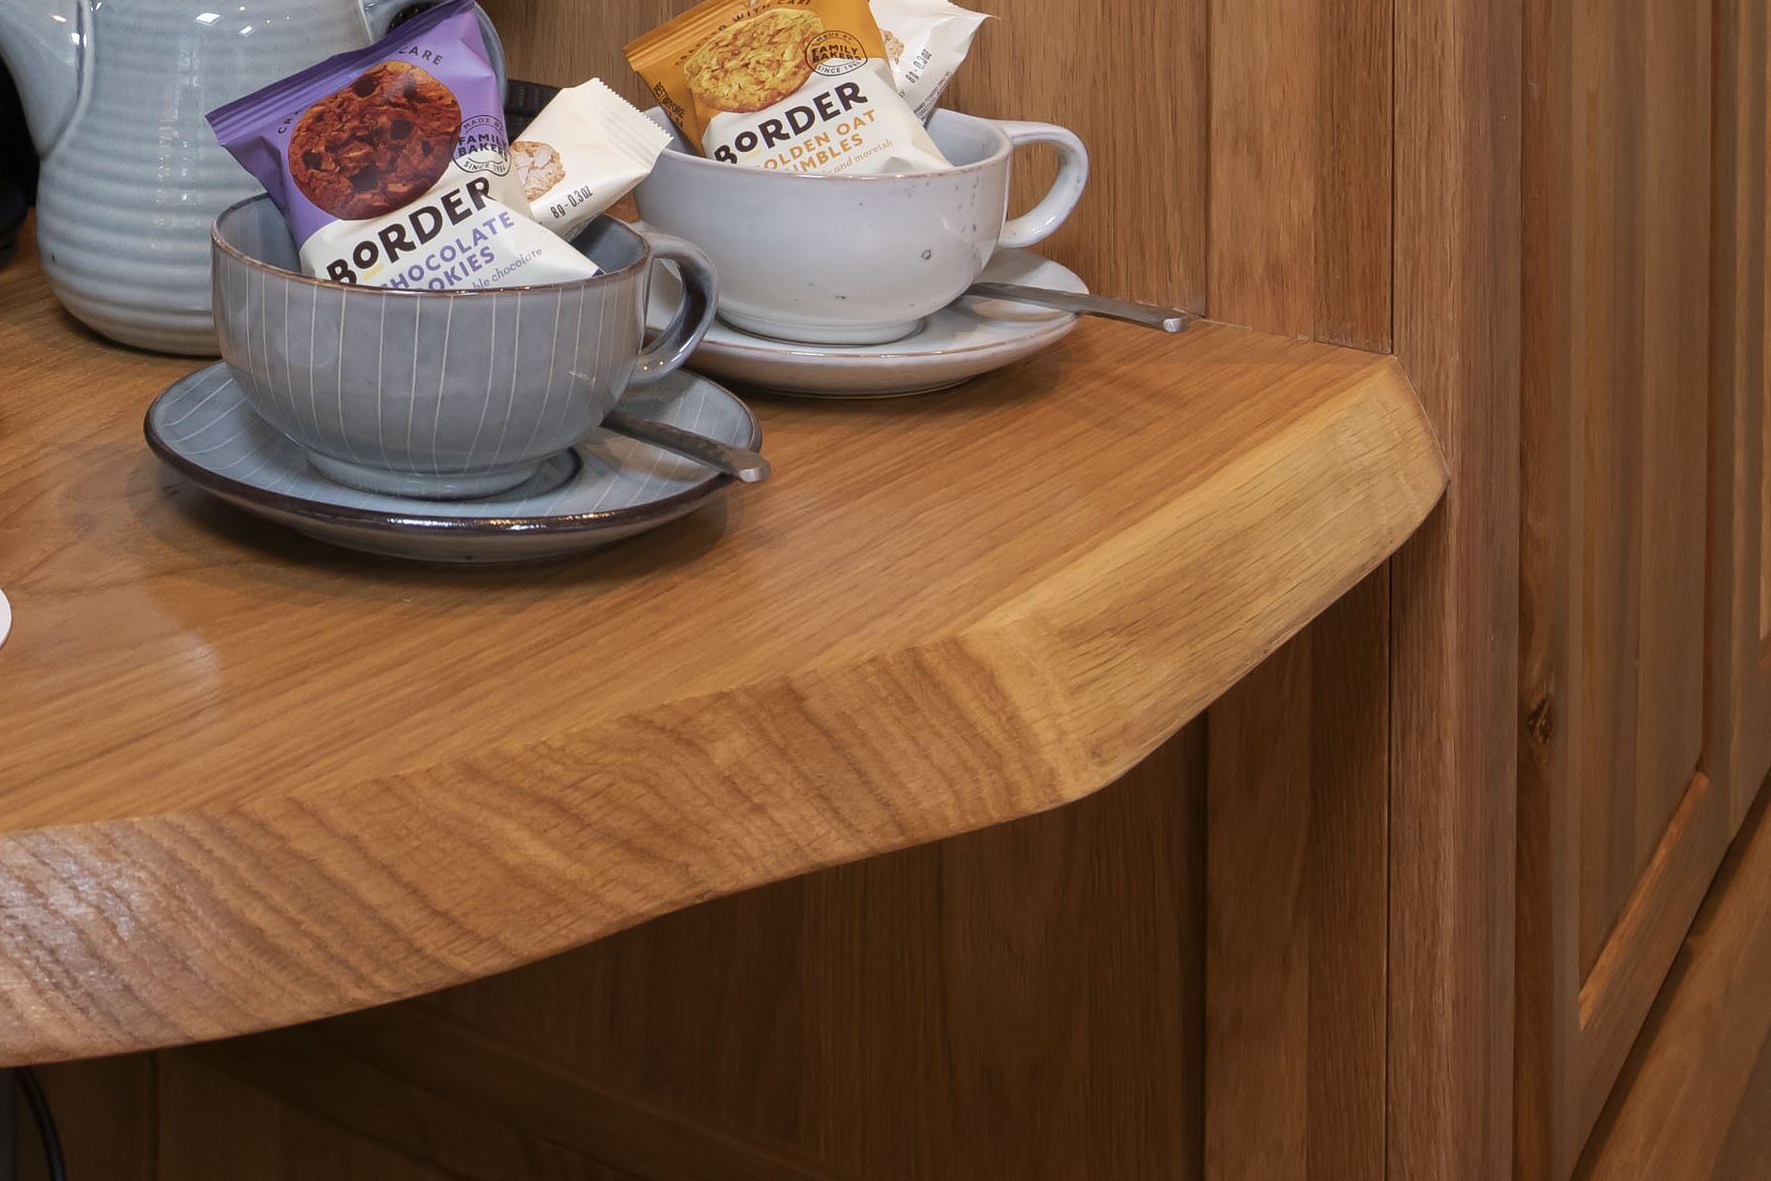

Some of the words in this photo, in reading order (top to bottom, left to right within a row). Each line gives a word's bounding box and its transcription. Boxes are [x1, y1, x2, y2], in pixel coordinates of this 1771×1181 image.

[811, 45, 859, 57] FAMILY
[812, 52, 862, 64] BAKERS
[816, 64, 841, 73] SINCE
[463, 117, 490, 130] MADE
[714, 82, 868, 164] BORDER
[764, 131, 830, 170] OLDEN
[836, 109, 876, 136] OAT
[463, 160, 490, 171] SINCE
[834, 159, 853, 173] and
[855, 139, 894, 163] moreish
[549, 204, 567, 219] 8g
[326, 177, 498, 284] BORDER
[381, 211, 515, 289] HOCOLATE
[491, 248, 543, 283] chocolate
